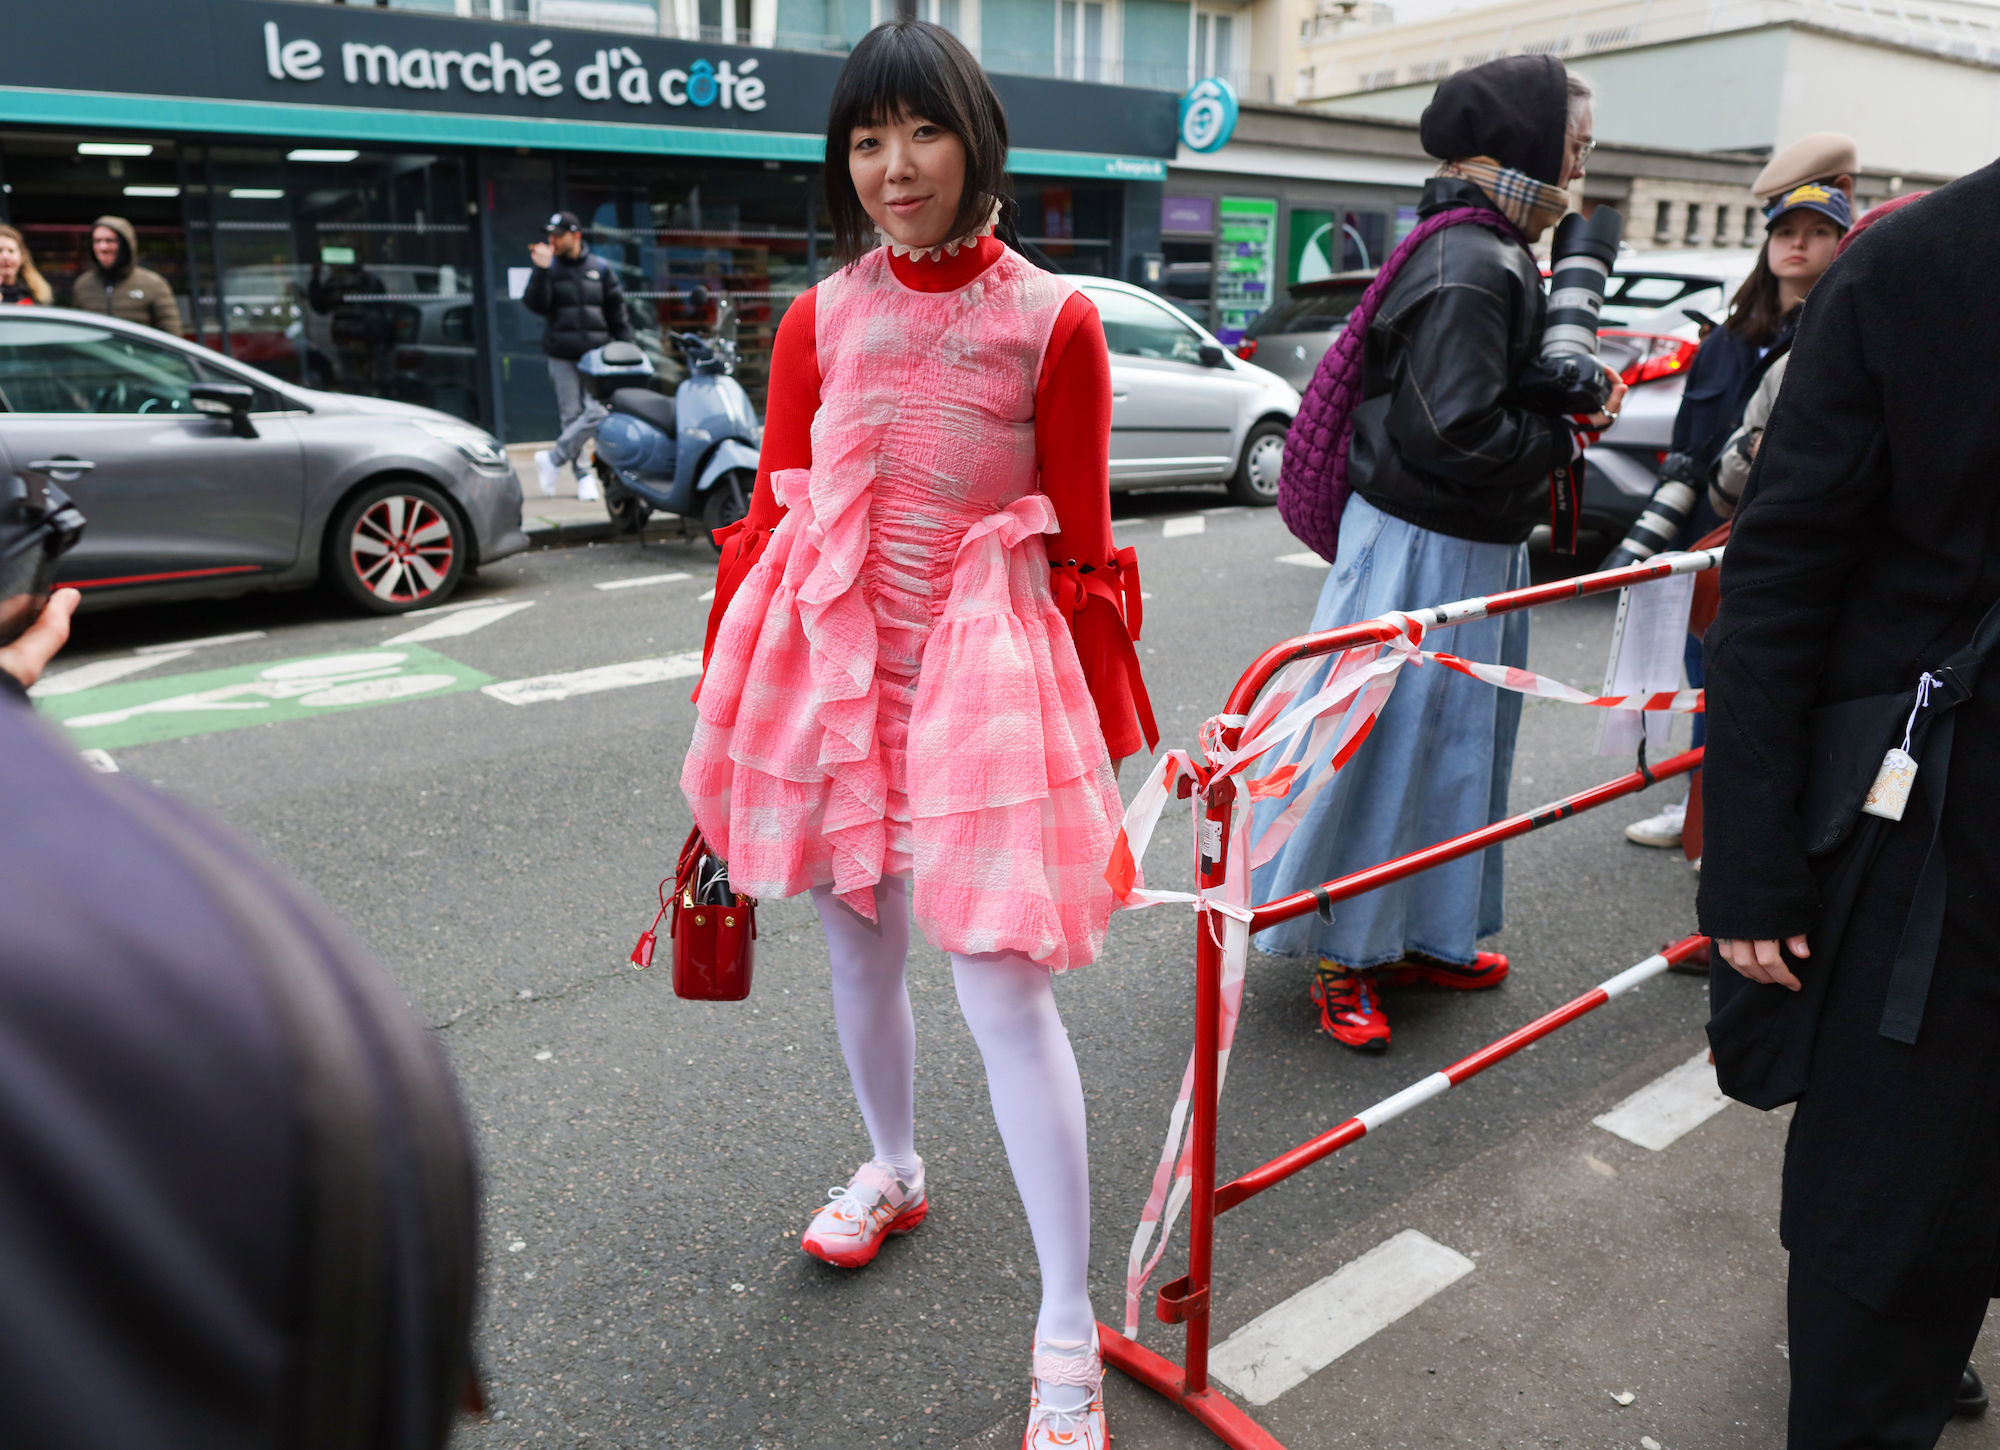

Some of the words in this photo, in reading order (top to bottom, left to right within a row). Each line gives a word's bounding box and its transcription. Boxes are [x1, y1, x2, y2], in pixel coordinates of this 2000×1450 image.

[264, 21, 324, 80] le
[341, 39, 563, 97] marché
[575, 46, 652, 104] d'à
[658, 58, 766, 112] côté
